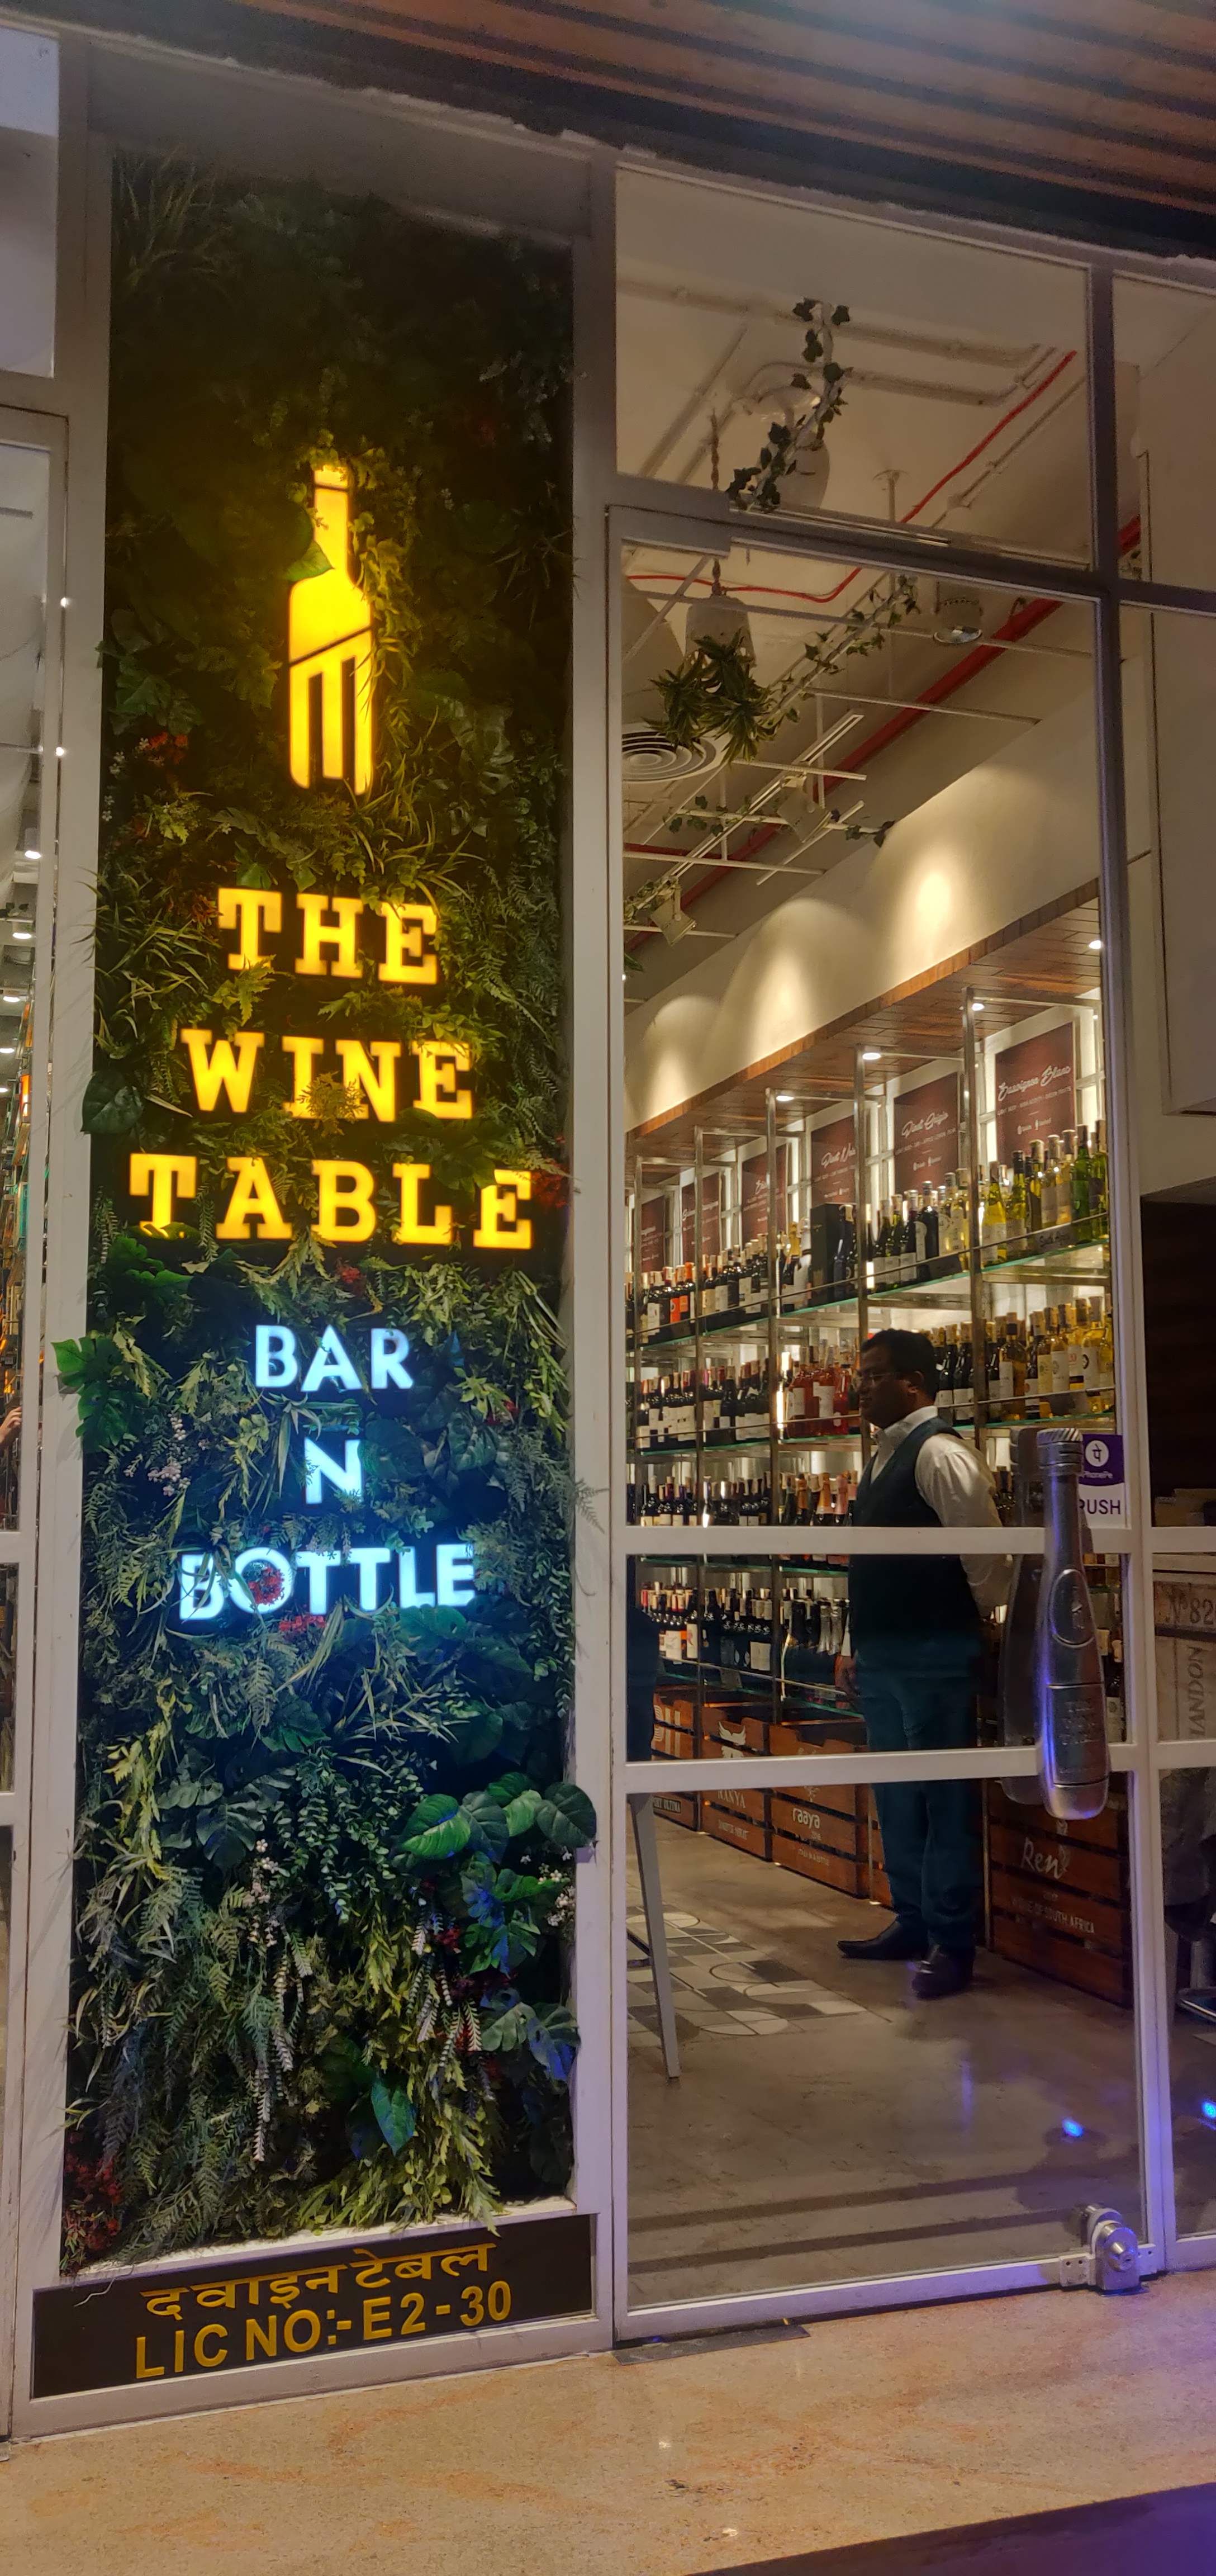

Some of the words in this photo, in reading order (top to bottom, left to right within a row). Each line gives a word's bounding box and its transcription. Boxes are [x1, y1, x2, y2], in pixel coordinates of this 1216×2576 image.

[218, 888, 438, 984] THE
[181, 1029, 472, 1121] WINE
[130, 1153, 531, 1249] TABLE
[255, 1324, 412, 1392] BAR
[304, 1438, 363, 1504] N
[179, 1544, 476, 1620] BOTTLE
[793, 1807, 820, 1829] raaya
[349, 2243, 497, 2289] टेबल
[136, 2323, 228, 2379] LIC
